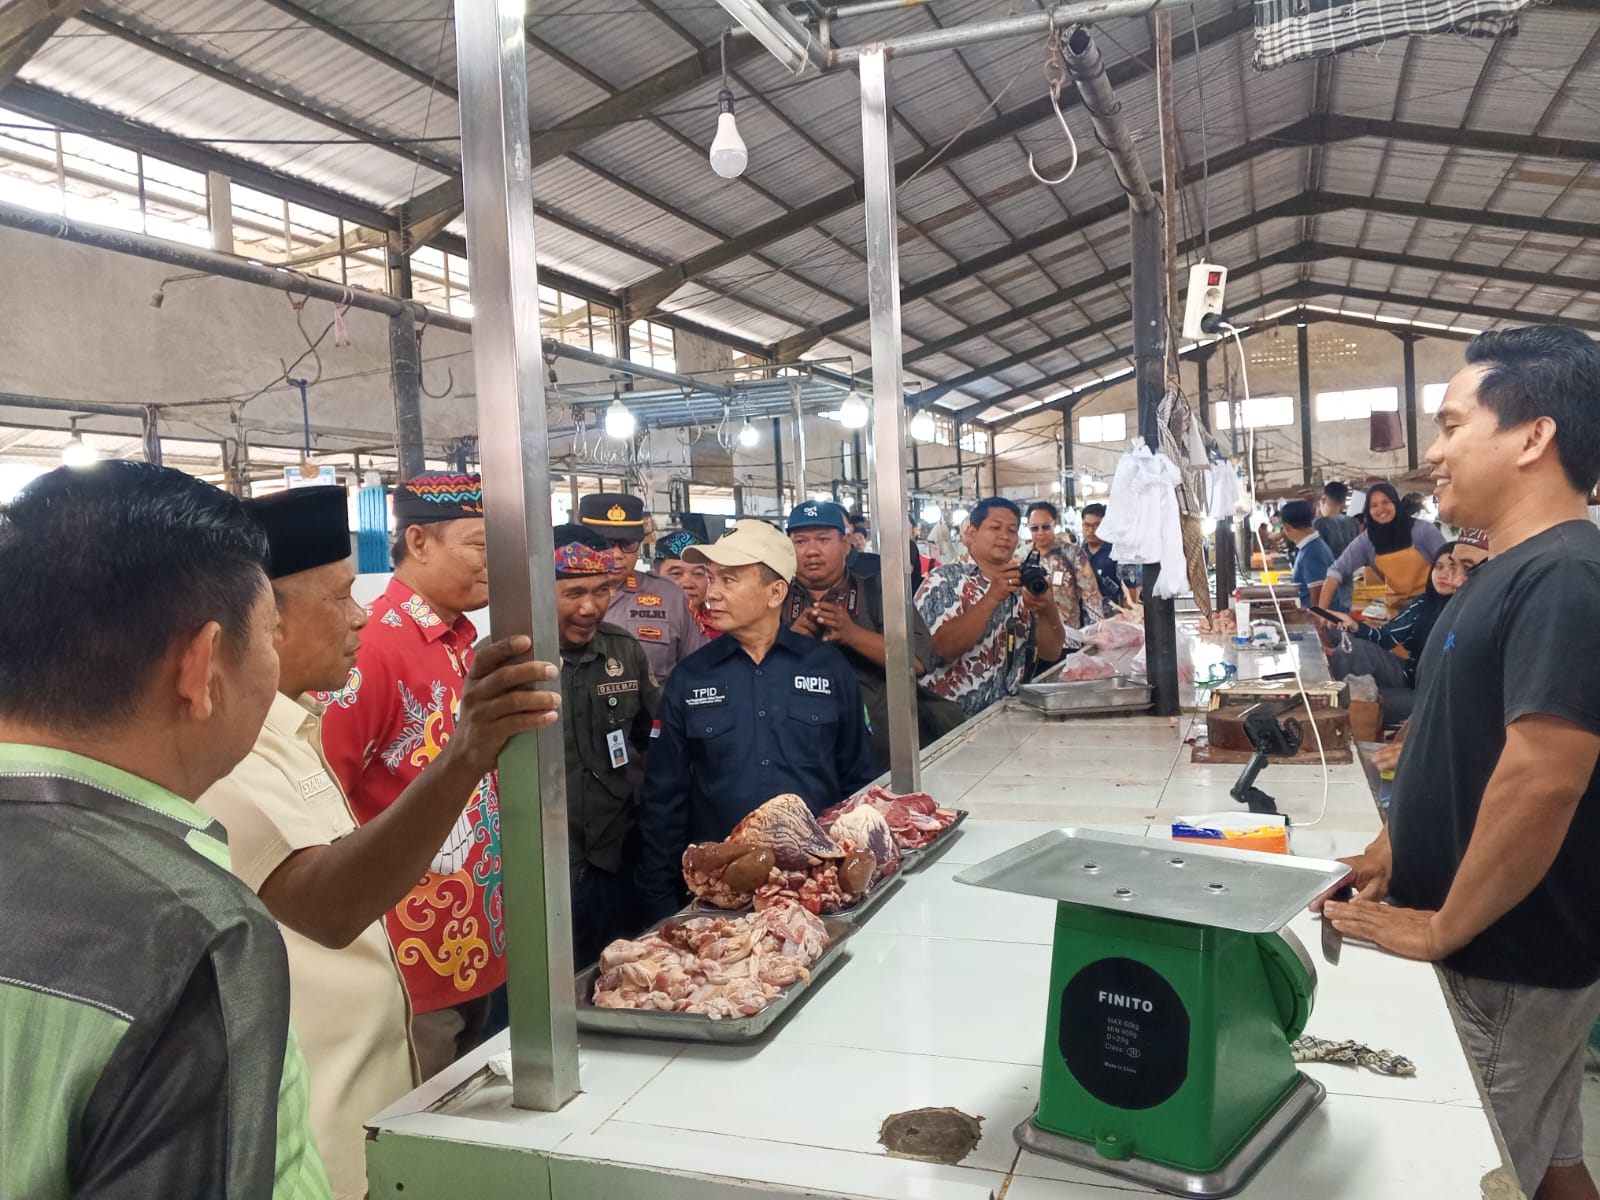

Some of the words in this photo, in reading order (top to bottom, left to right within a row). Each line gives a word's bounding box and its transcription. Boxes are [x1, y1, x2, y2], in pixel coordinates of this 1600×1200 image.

[630, 609, 666, 619] POLRI
[794, 675, 831, 694] GNPIP
[692, 687, 717, 698] TPID
[1098, 990, 1153, 1013] FINITO
[1107, 1017, 1122, 1026] MAX
[1107, 1025, 1120, 1034] MIN
